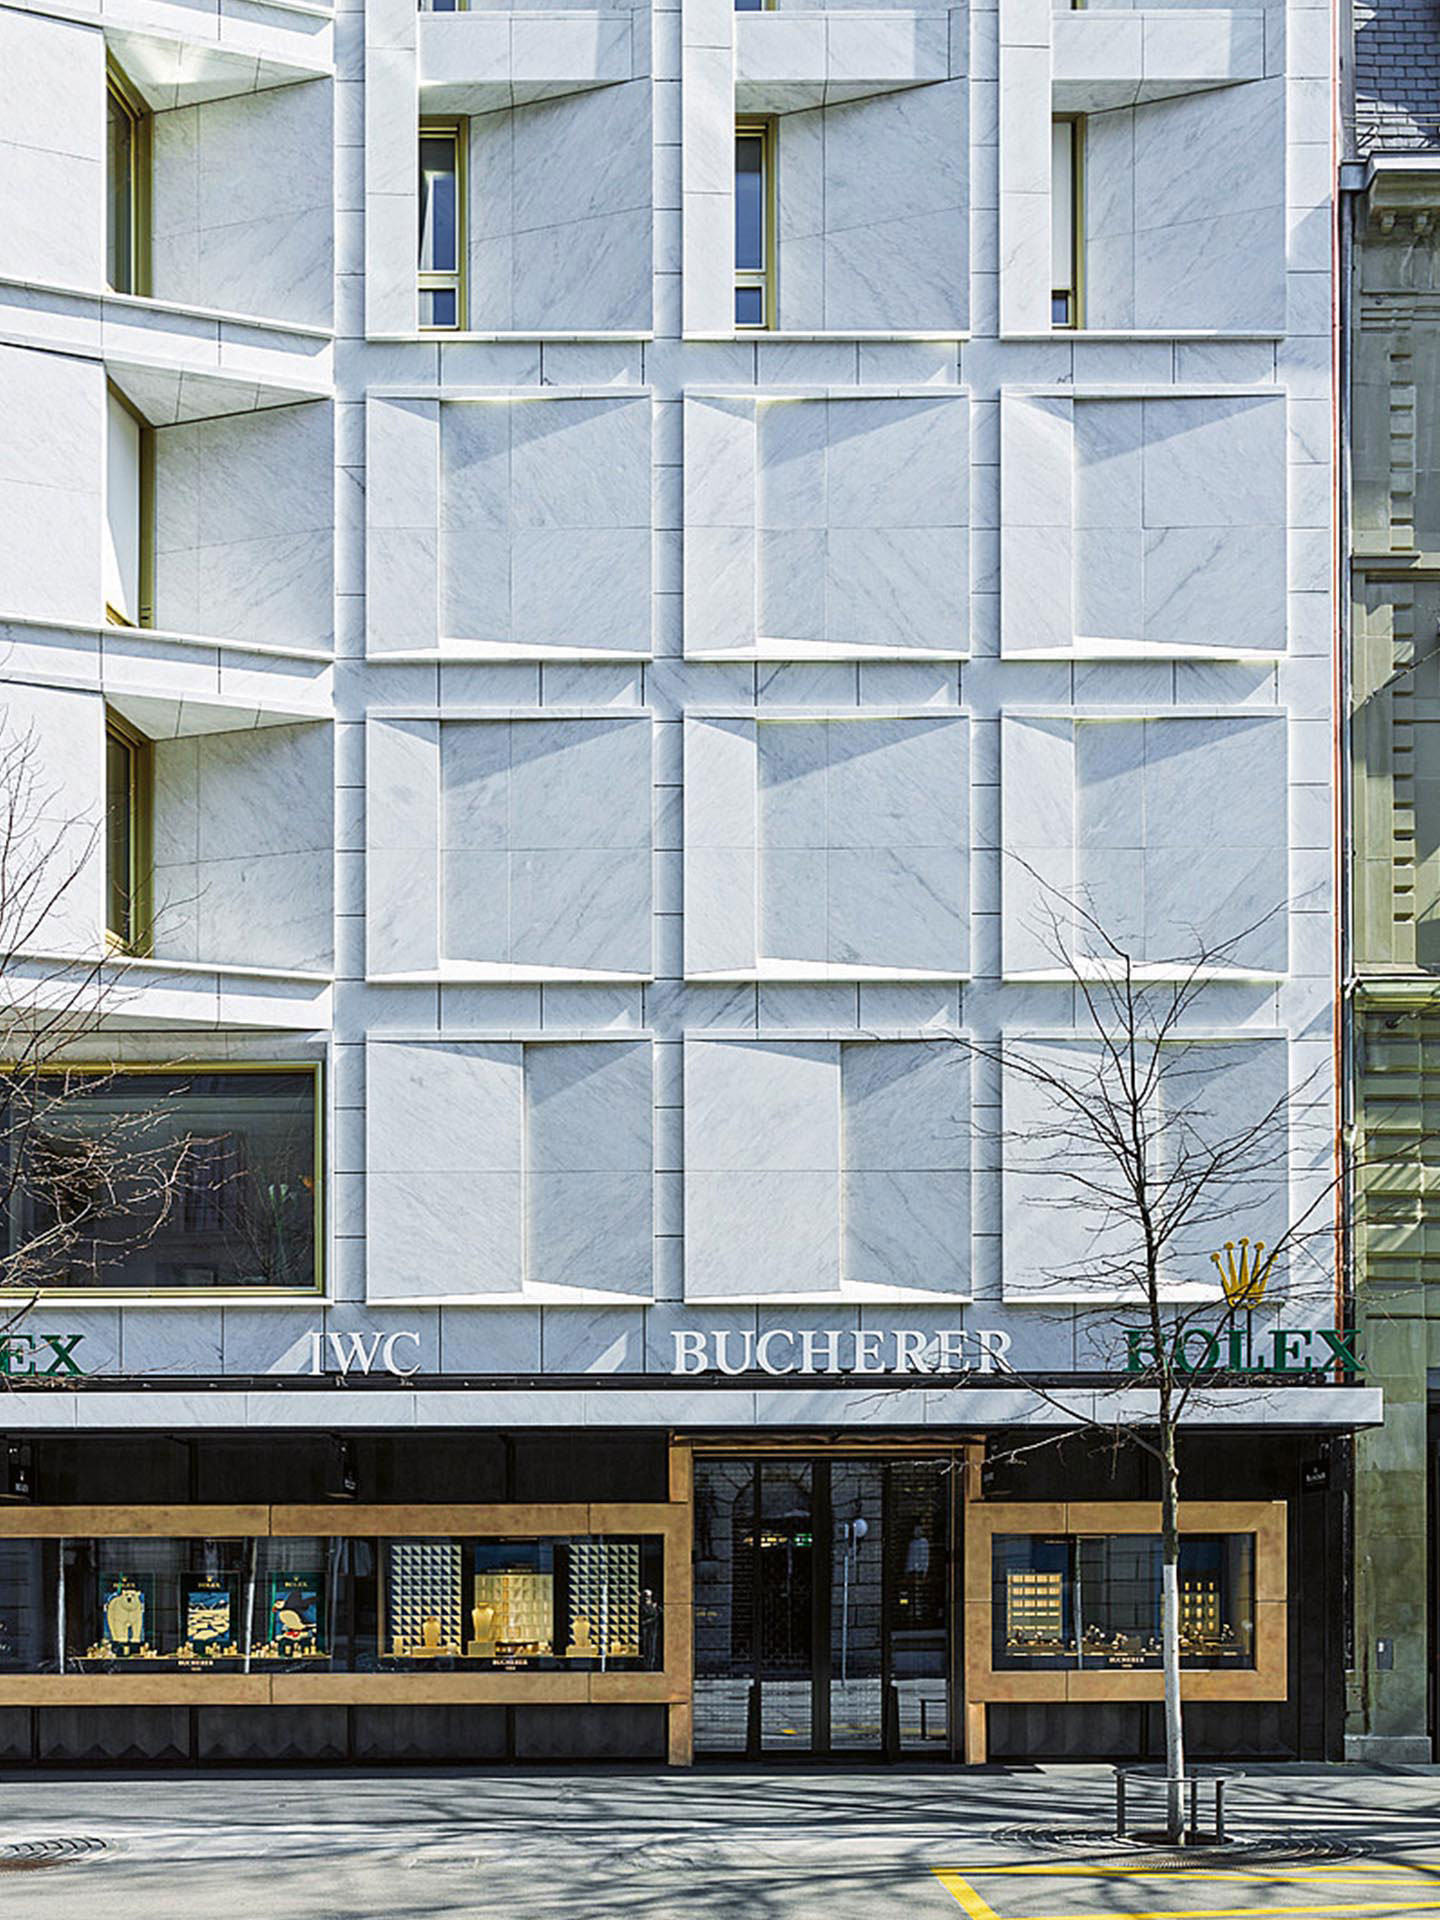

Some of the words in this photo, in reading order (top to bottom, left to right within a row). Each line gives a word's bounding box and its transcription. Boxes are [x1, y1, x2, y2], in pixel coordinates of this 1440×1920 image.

[308, 1331, 421, 1376] IWC
[670, 1330, 1015, 1375] BUCHERER
[1123, 1329, 1366, 1373] ROLEX
